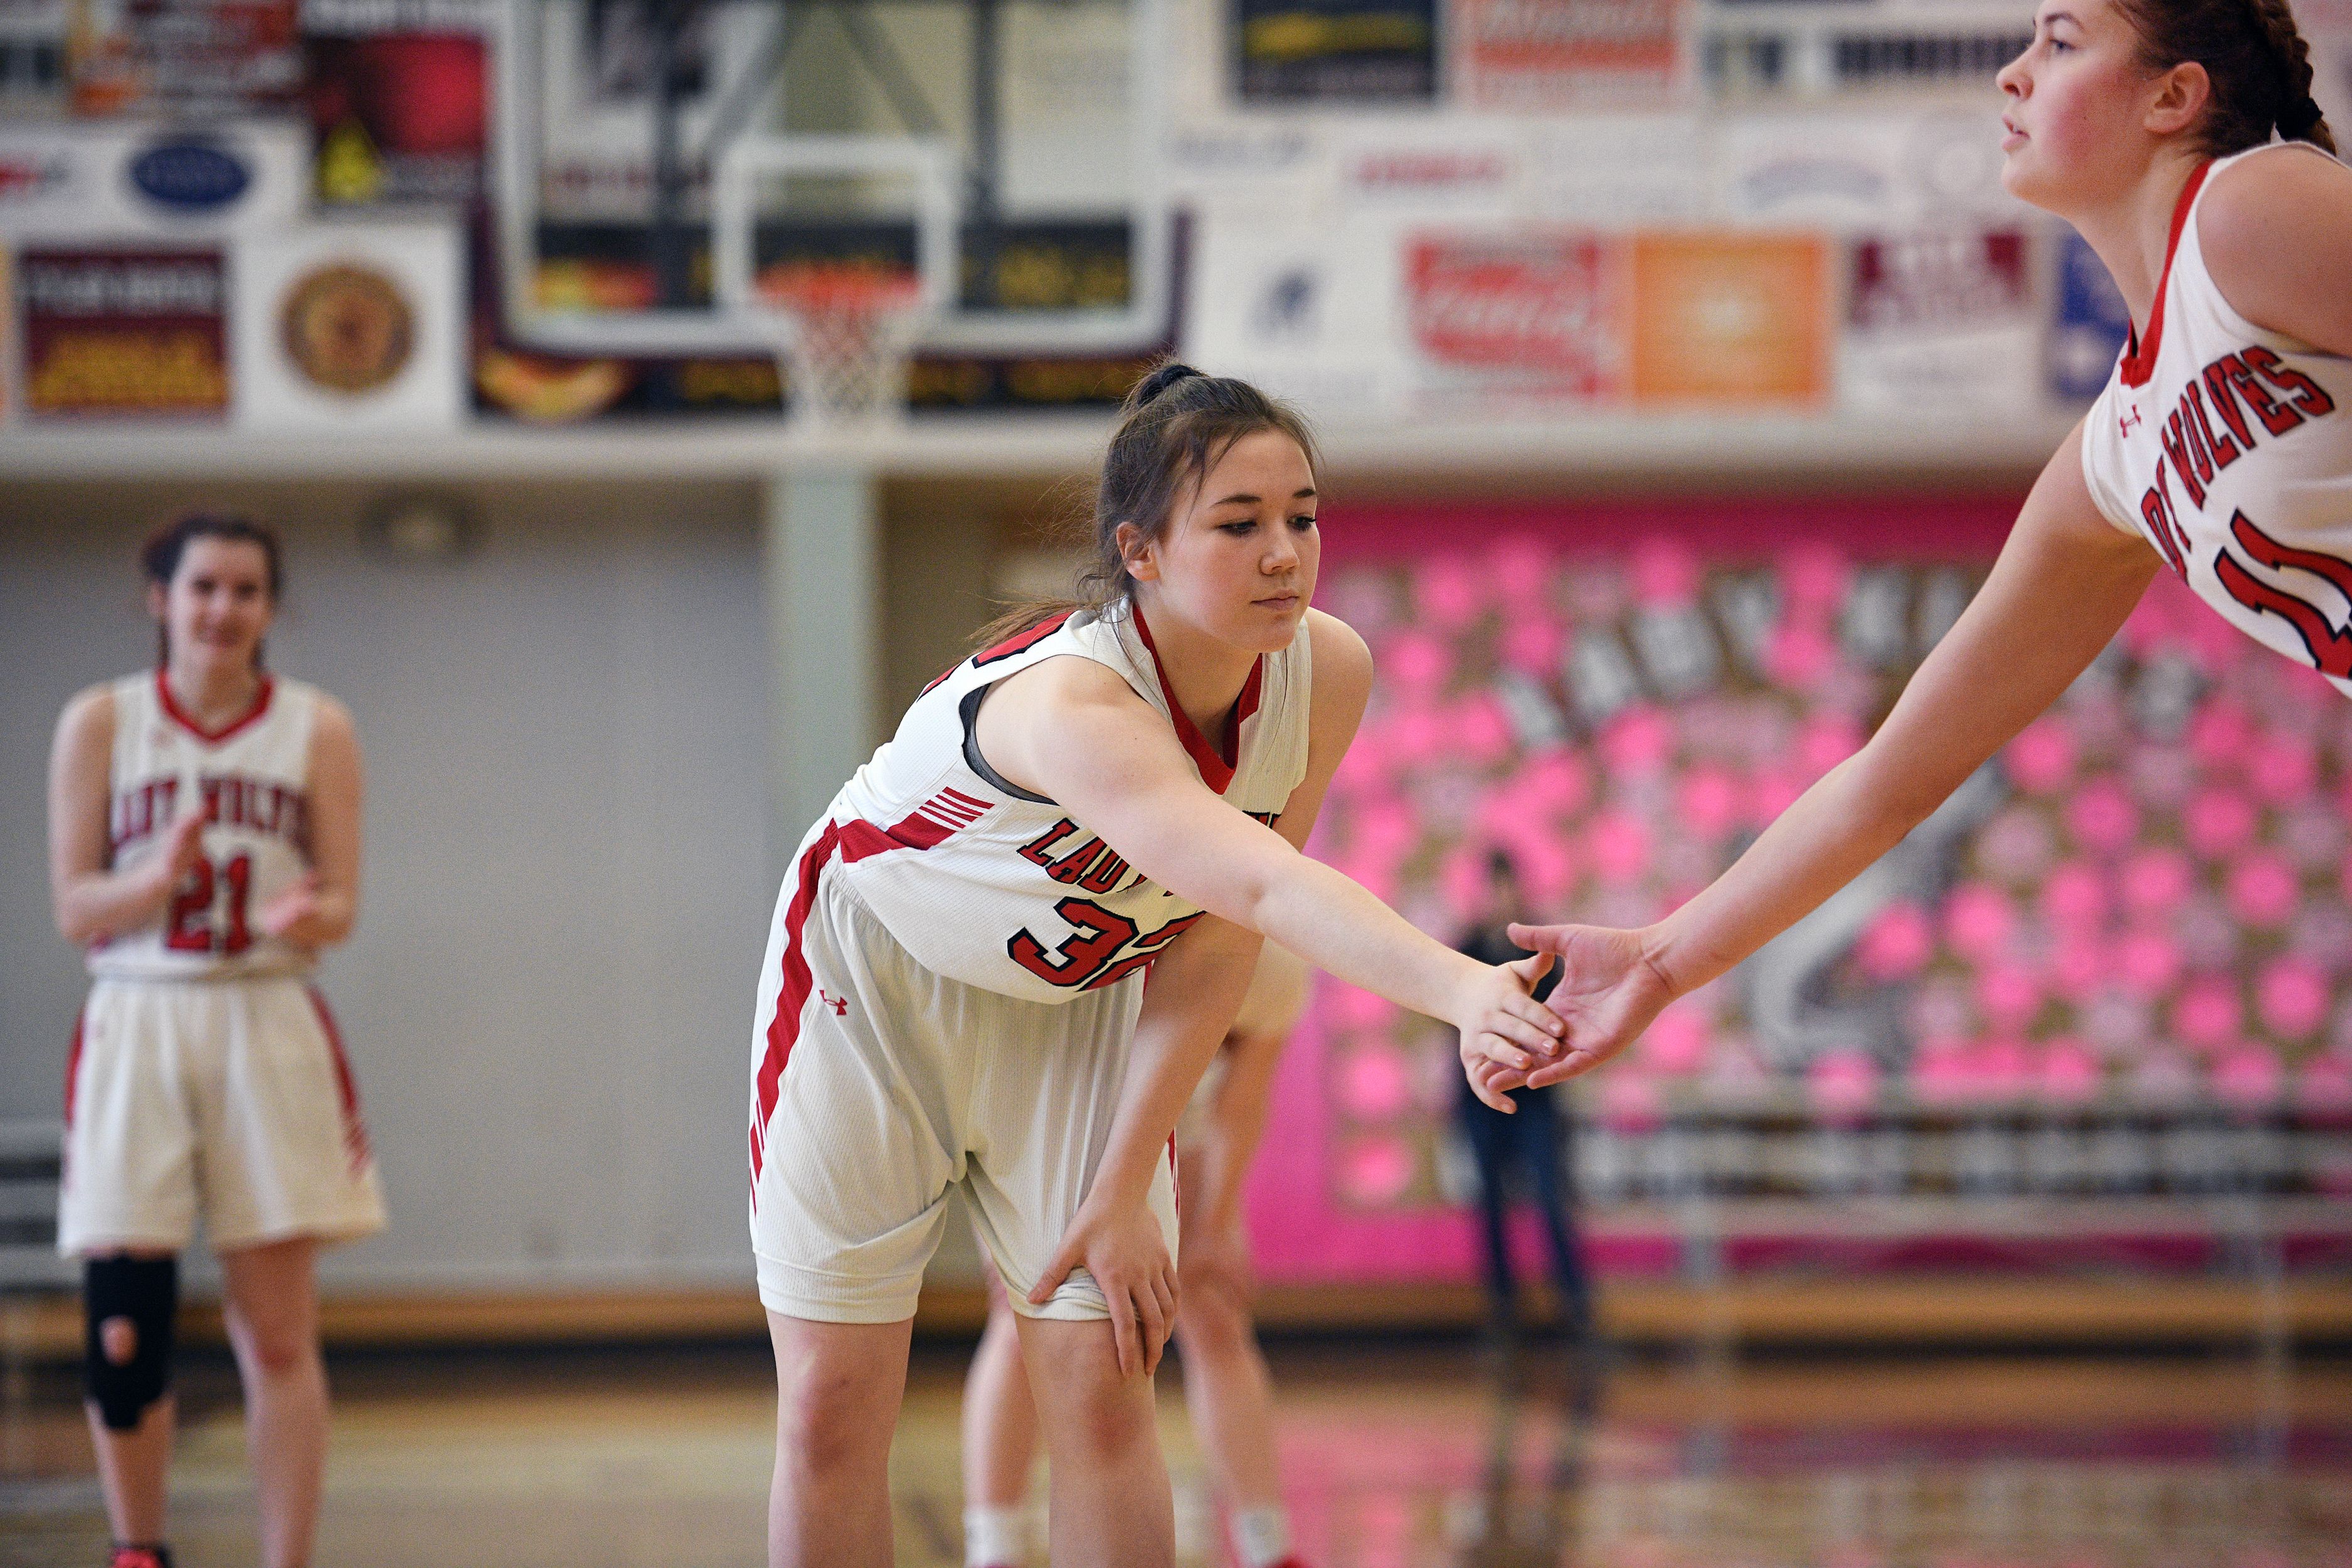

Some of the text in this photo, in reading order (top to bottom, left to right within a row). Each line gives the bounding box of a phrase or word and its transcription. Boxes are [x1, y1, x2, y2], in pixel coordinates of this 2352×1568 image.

[2161, 344, 2335, 511] WOLVES
[2213, 506, 2352, 680] 11
[166, 850, 251, 953] 21
